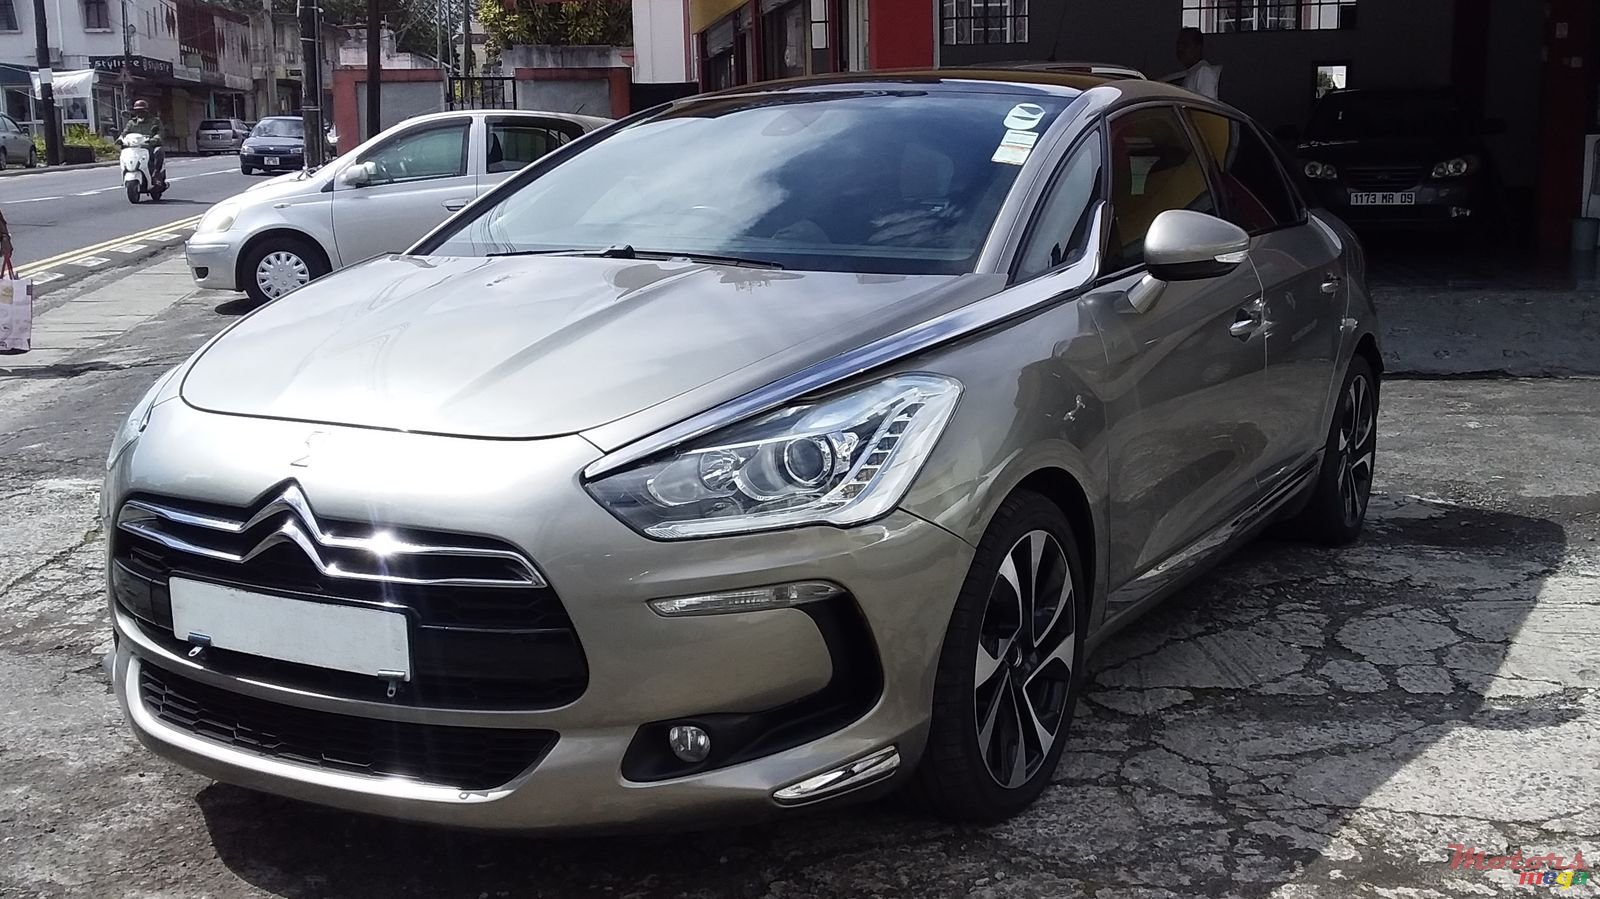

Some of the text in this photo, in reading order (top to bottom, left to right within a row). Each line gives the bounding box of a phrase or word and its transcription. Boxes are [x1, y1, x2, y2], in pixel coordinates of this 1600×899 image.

[95, 59, 140, 70] stylise
[1354, 193, 1377, 204] 1173
[1401, 193, 1413, 204] 09
